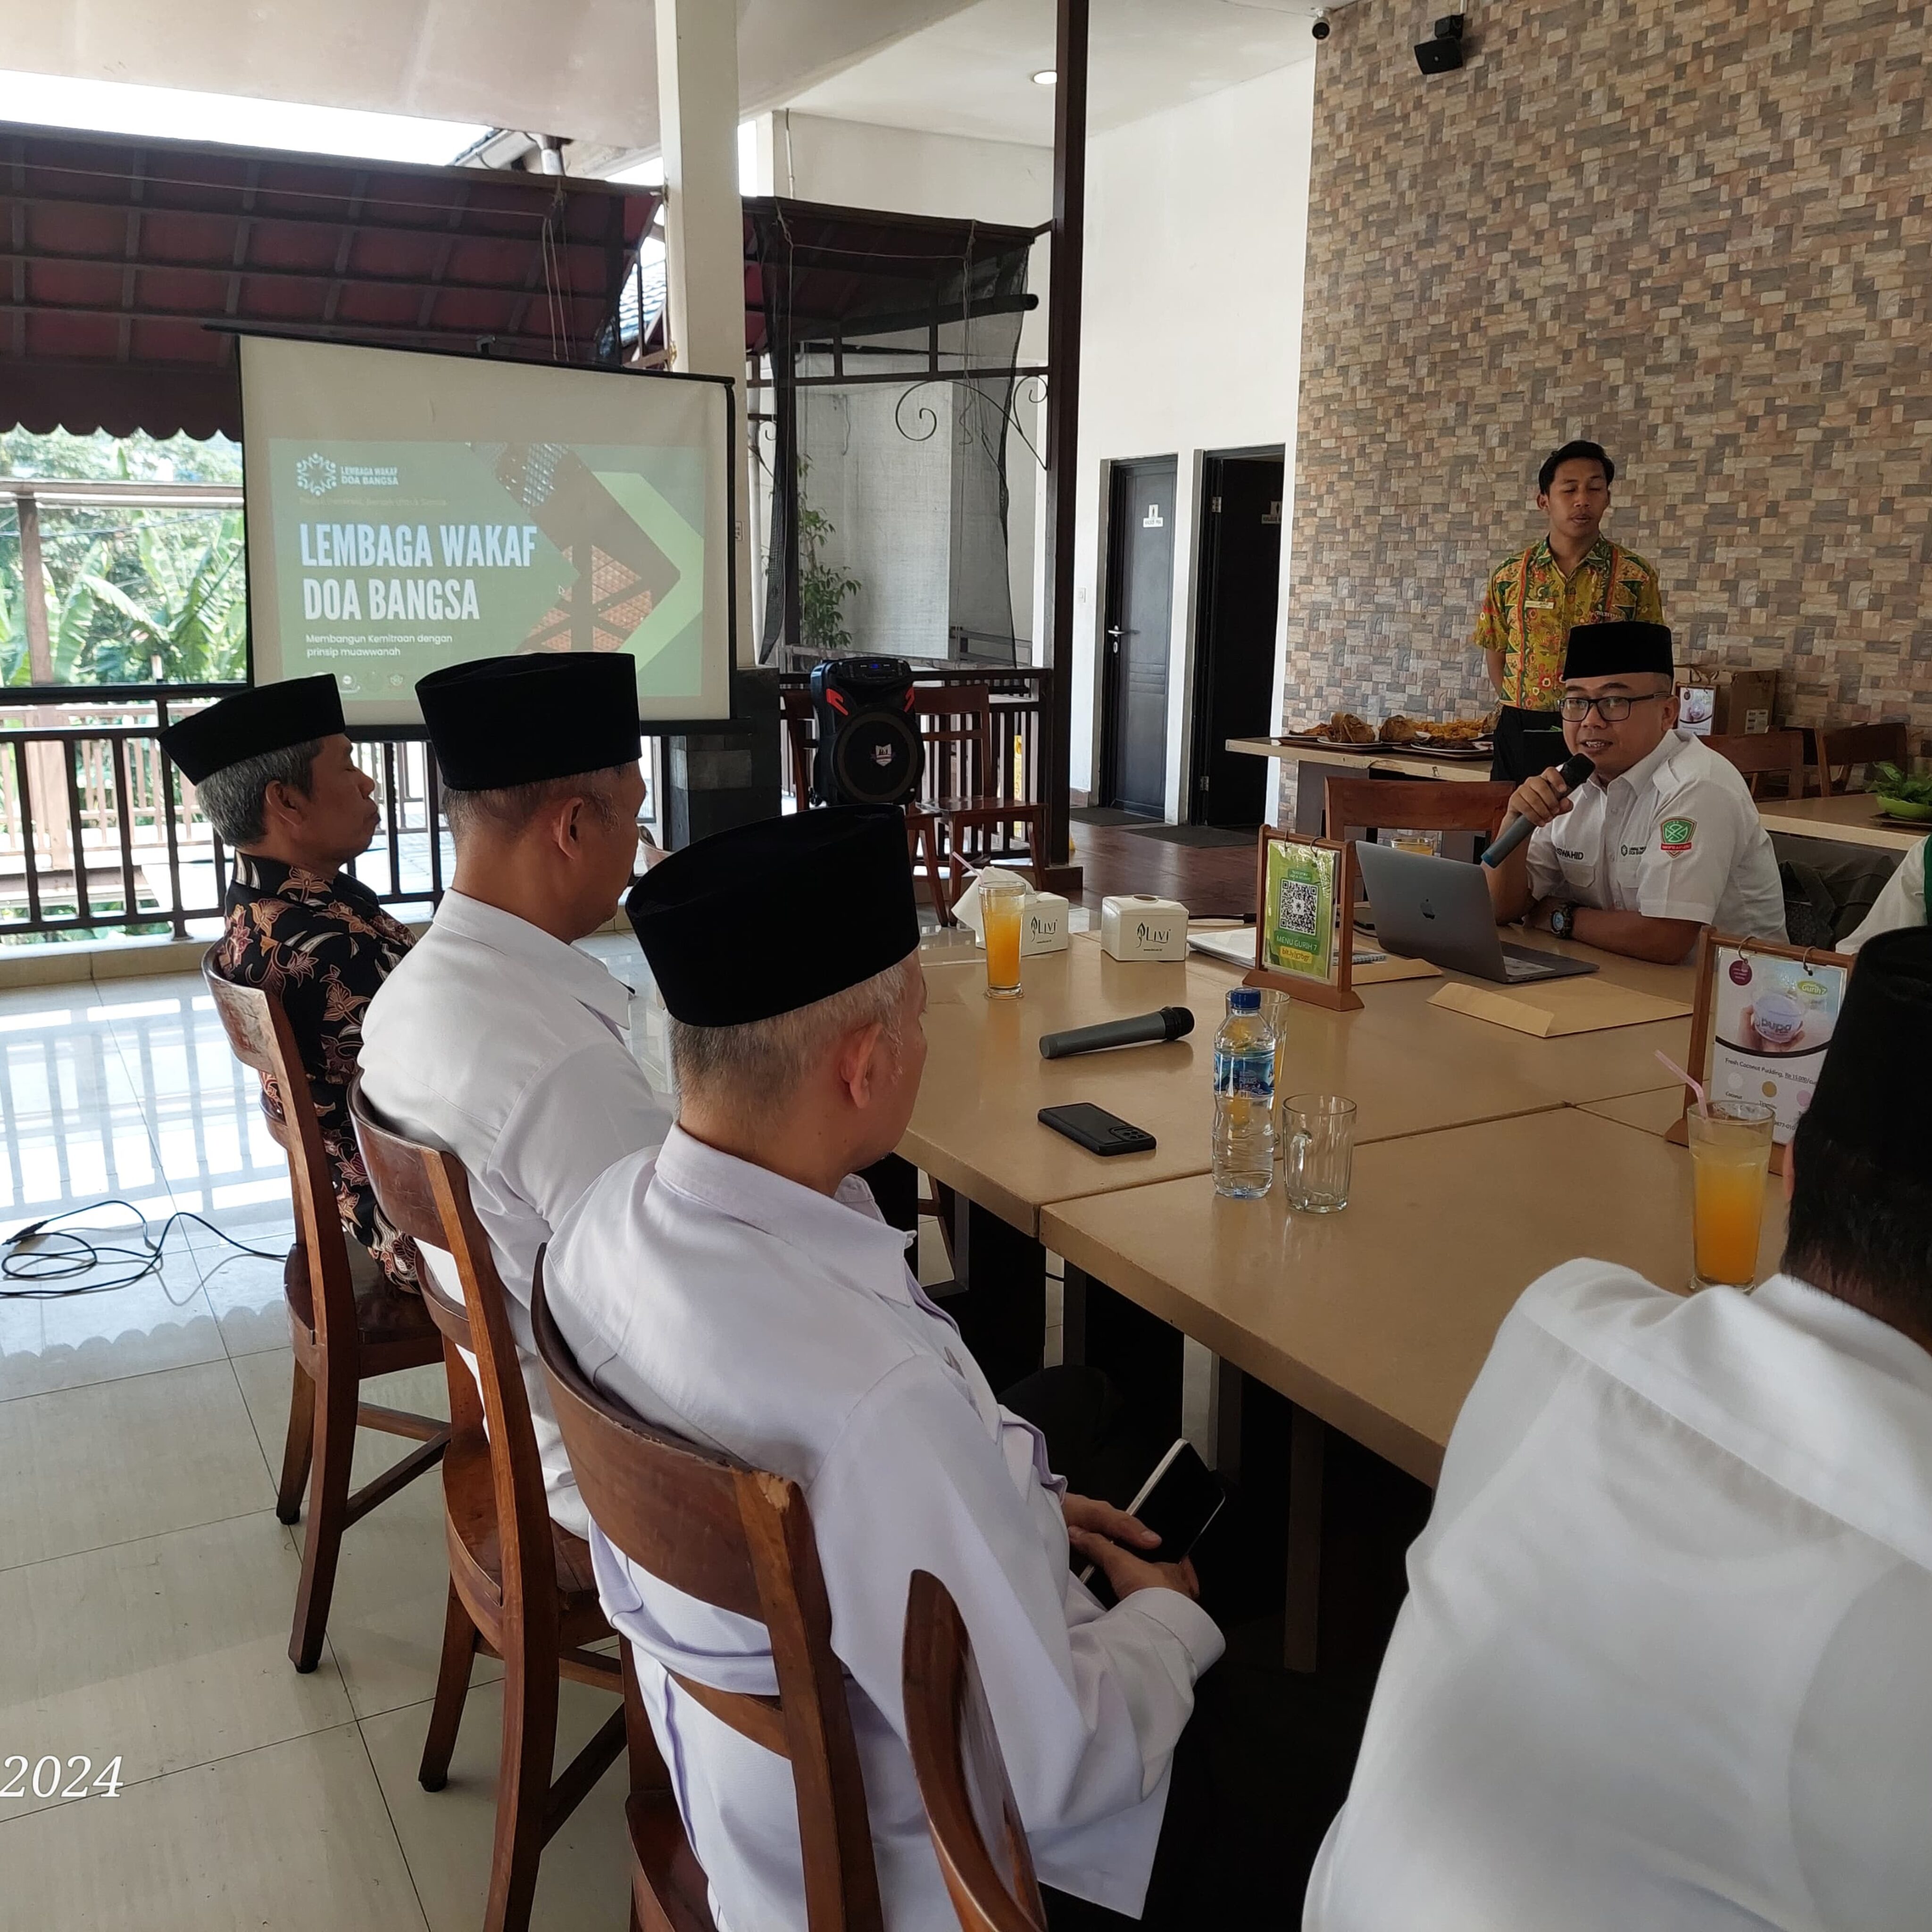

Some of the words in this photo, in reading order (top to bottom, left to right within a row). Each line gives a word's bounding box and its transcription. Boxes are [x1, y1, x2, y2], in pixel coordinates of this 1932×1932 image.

[341, 476, 361, 485] DOA
[362, 476, 399, 485] BANGSA
[300, 523, 433, 567] LEMBAGA
[439, 525, 537, 567] WAKAF
[303, 578, 362, 620] DOA
[368, 579, 480, 620] BANGSA
[306, 634, 366, 645] Membangun
[368, 634, 415, 643] Kemitraan
[417, 634, 453, 645] dengan
[307, 647, 339, 658] prinsip
[340, 647, 401, 657] muawwanah
[1276, 935, 1293, 945] MENU
[1294, 940, 1312, 950] GURIH
[1725, 1058, 1739, 1066] Fresh
[1739, 1061, 1761, 1071] Coconut
